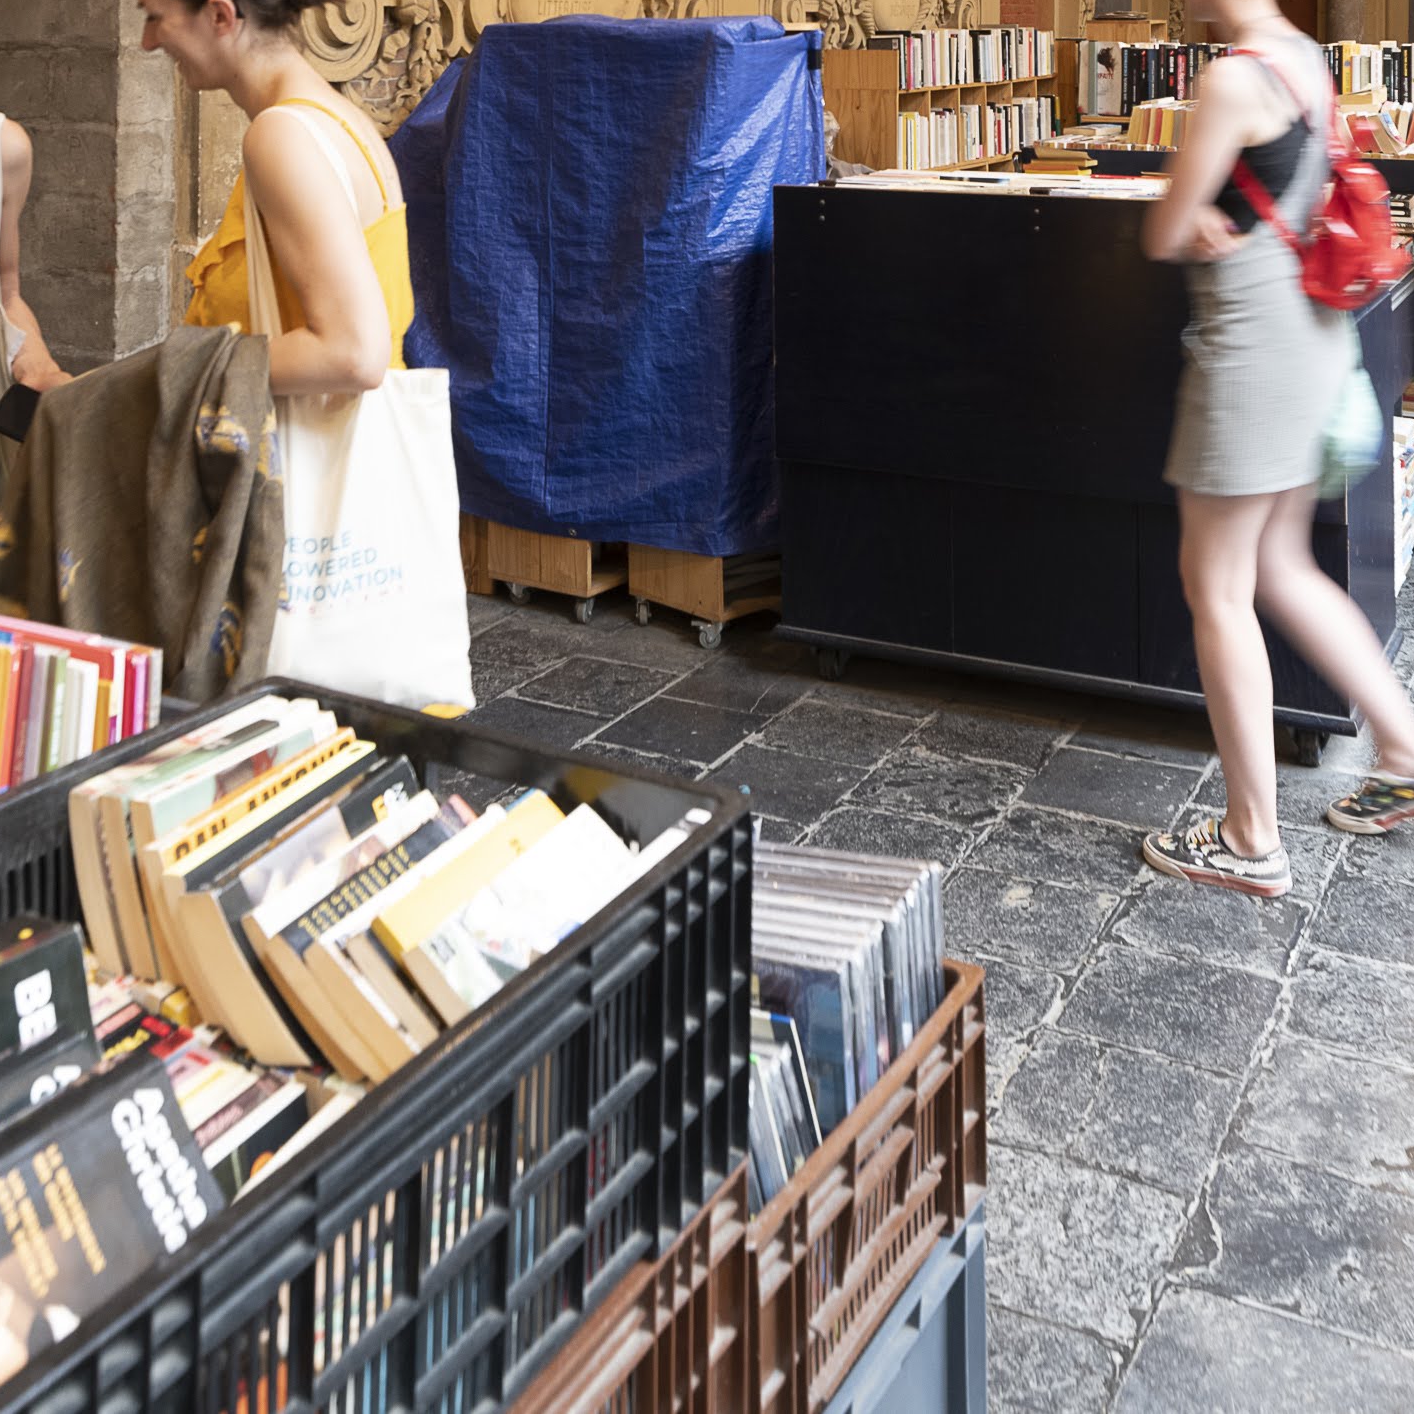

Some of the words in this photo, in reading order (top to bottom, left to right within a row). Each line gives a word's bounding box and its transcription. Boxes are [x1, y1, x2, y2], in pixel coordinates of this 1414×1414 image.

[285, 531, 353, 555] EOPLE
[282, 547, 378, 578] OWERED
[288, 566, 403, 603] NOVATION
[111, 1097, 188, 1255] Christie
[133, 1088, 208, 1231] Agatha
